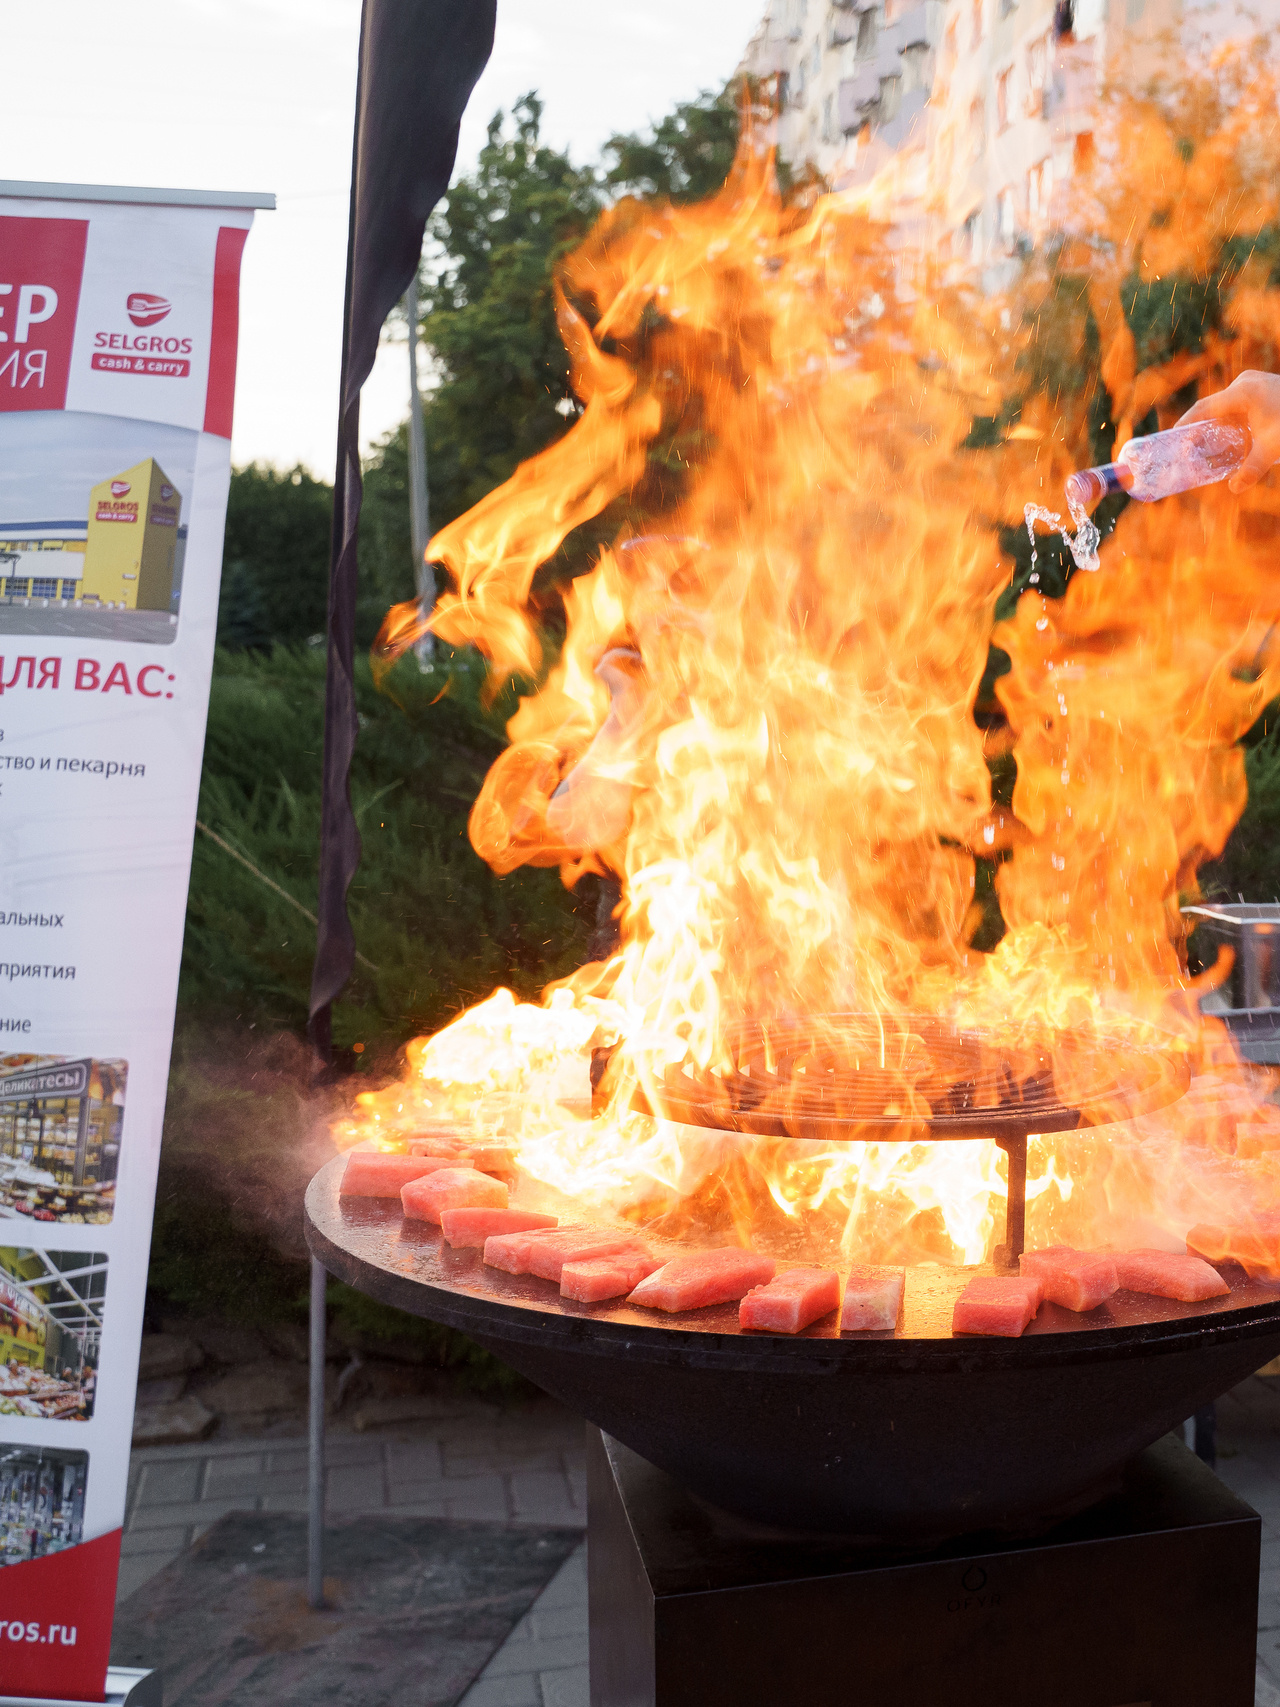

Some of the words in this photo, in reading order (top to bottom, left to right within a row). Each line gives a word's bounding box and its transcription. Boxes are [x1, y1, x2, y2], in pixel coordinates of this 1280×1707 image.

[94, 332, 193, 354] SELGROS
[99, 356, 131, 370] cash
[134, 358, 145, 371] &
[147, 361, 184, 376] carry
[0, 656, 61, 695] ЛЯ
[74, 658, 176, 699] ВАС:
[40, 757, 51, 770] и
[56, 757, 146, 779] пекарня
[0, 963, 76, 982] приятия
[0, 1018, 31, 1033] ние
